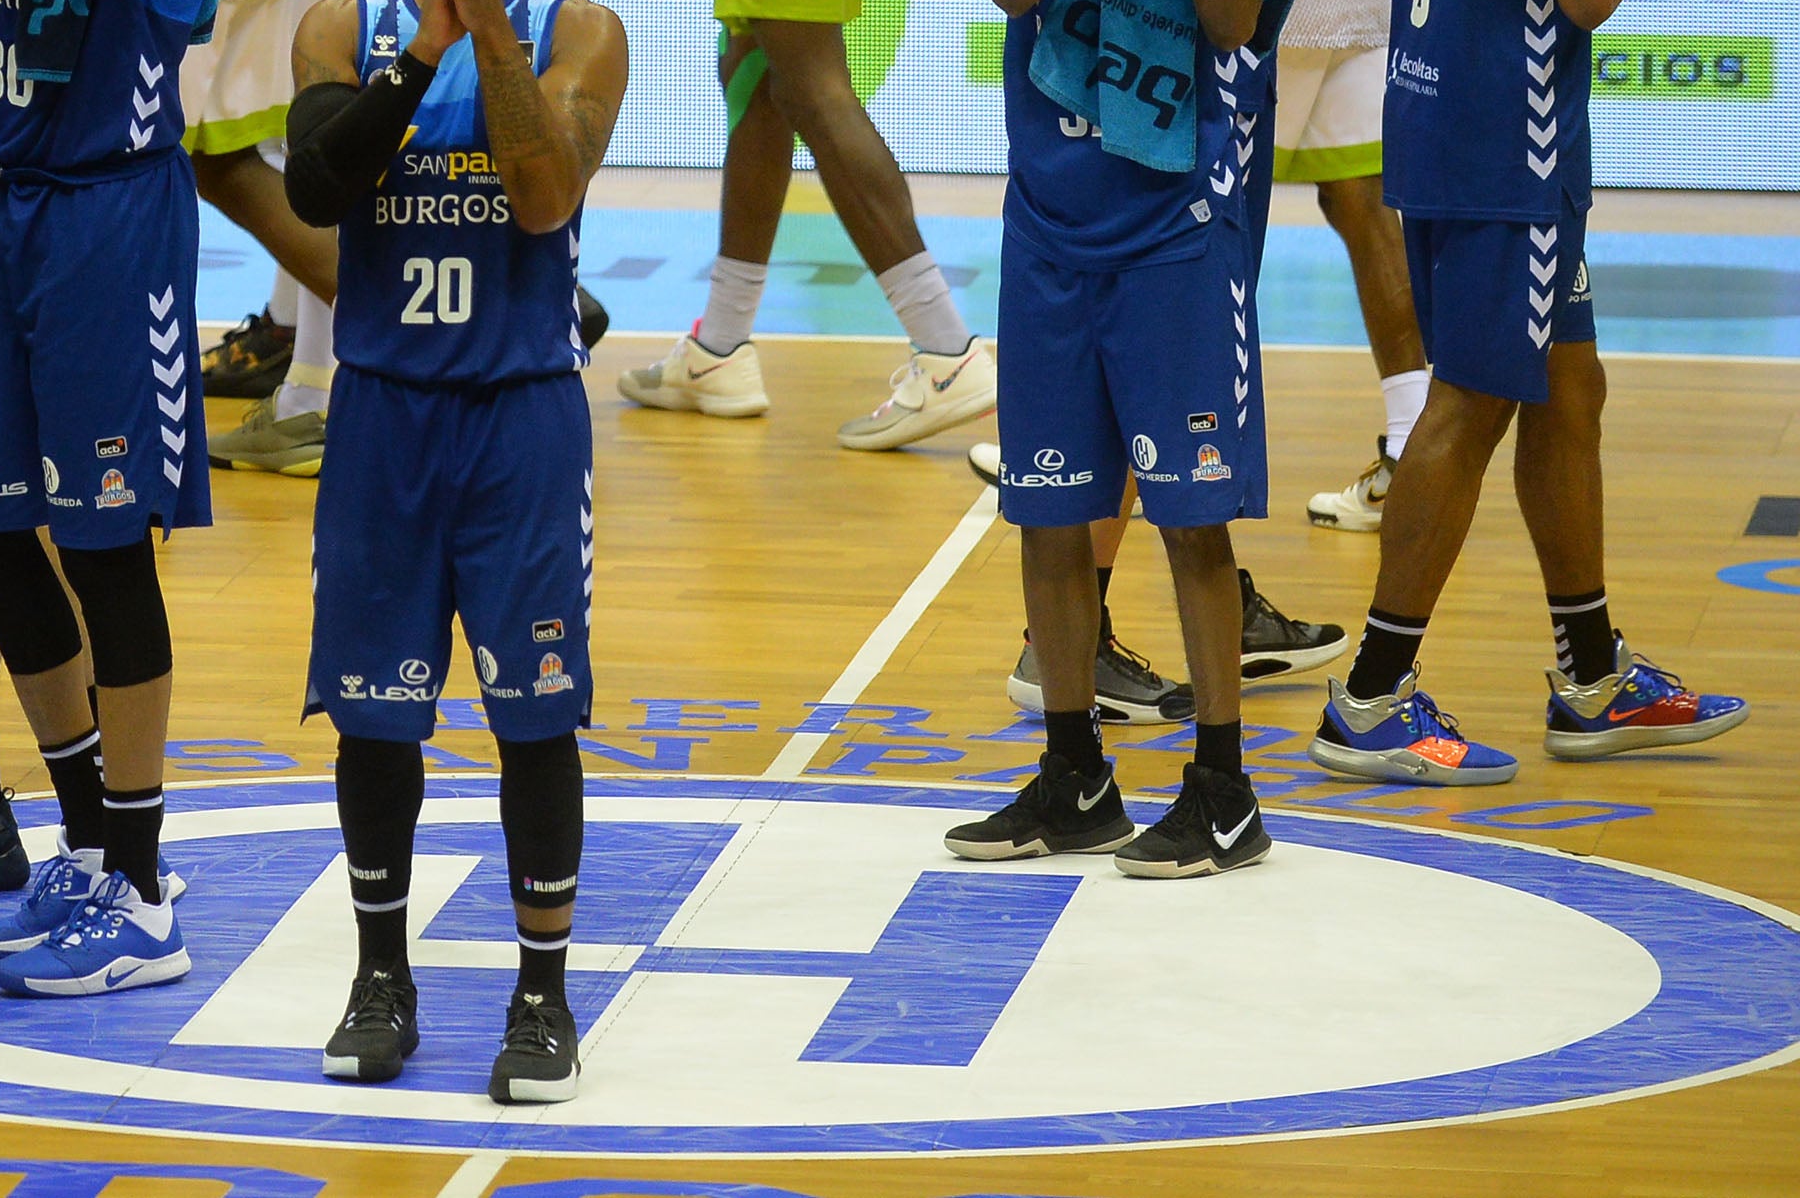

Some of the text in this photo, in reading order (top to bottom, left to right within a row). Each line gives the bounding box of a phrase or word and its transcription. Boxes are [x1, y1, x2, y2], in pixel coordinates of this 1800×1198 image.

[375, 193, 510, 226] BURGOS
[400, 257, 473, 324] 20
[1010, 470, 1094, 488] LEXUS
[369, 684, 440, 702] LEXU
